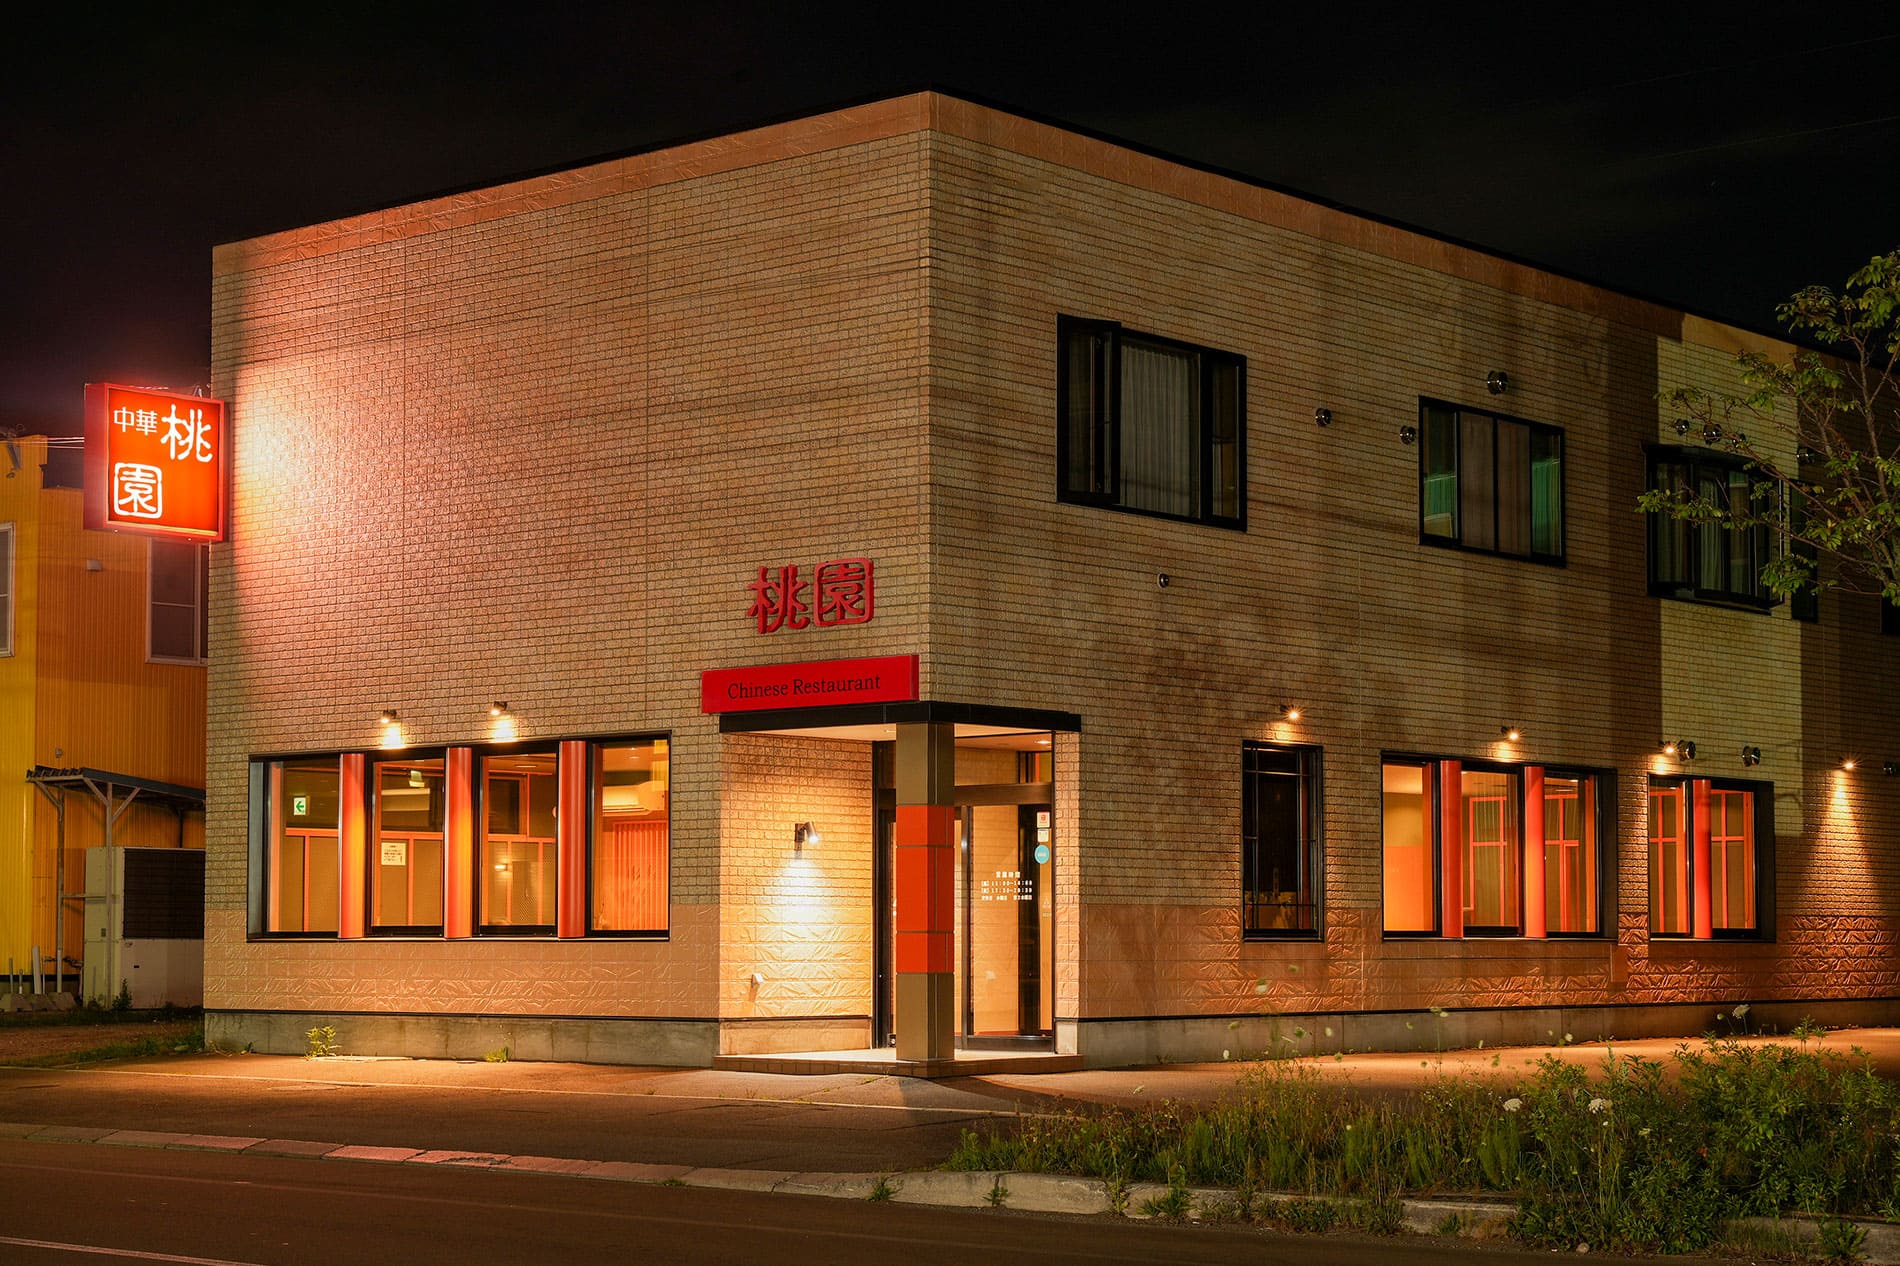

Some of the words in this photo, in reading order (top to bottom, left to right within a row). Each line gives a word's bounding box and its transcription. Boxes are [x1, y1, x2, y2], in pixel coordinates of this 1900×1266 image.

[113, 406, 158, 436] 中華
[160, 403, 213, 463] 桃
[113, 462, 162, 519] 園
[747, 557, 875, 635] 桃園
[727, 682, 789, 700] Chinese
[793, 676, 881, 695] Restaurant
